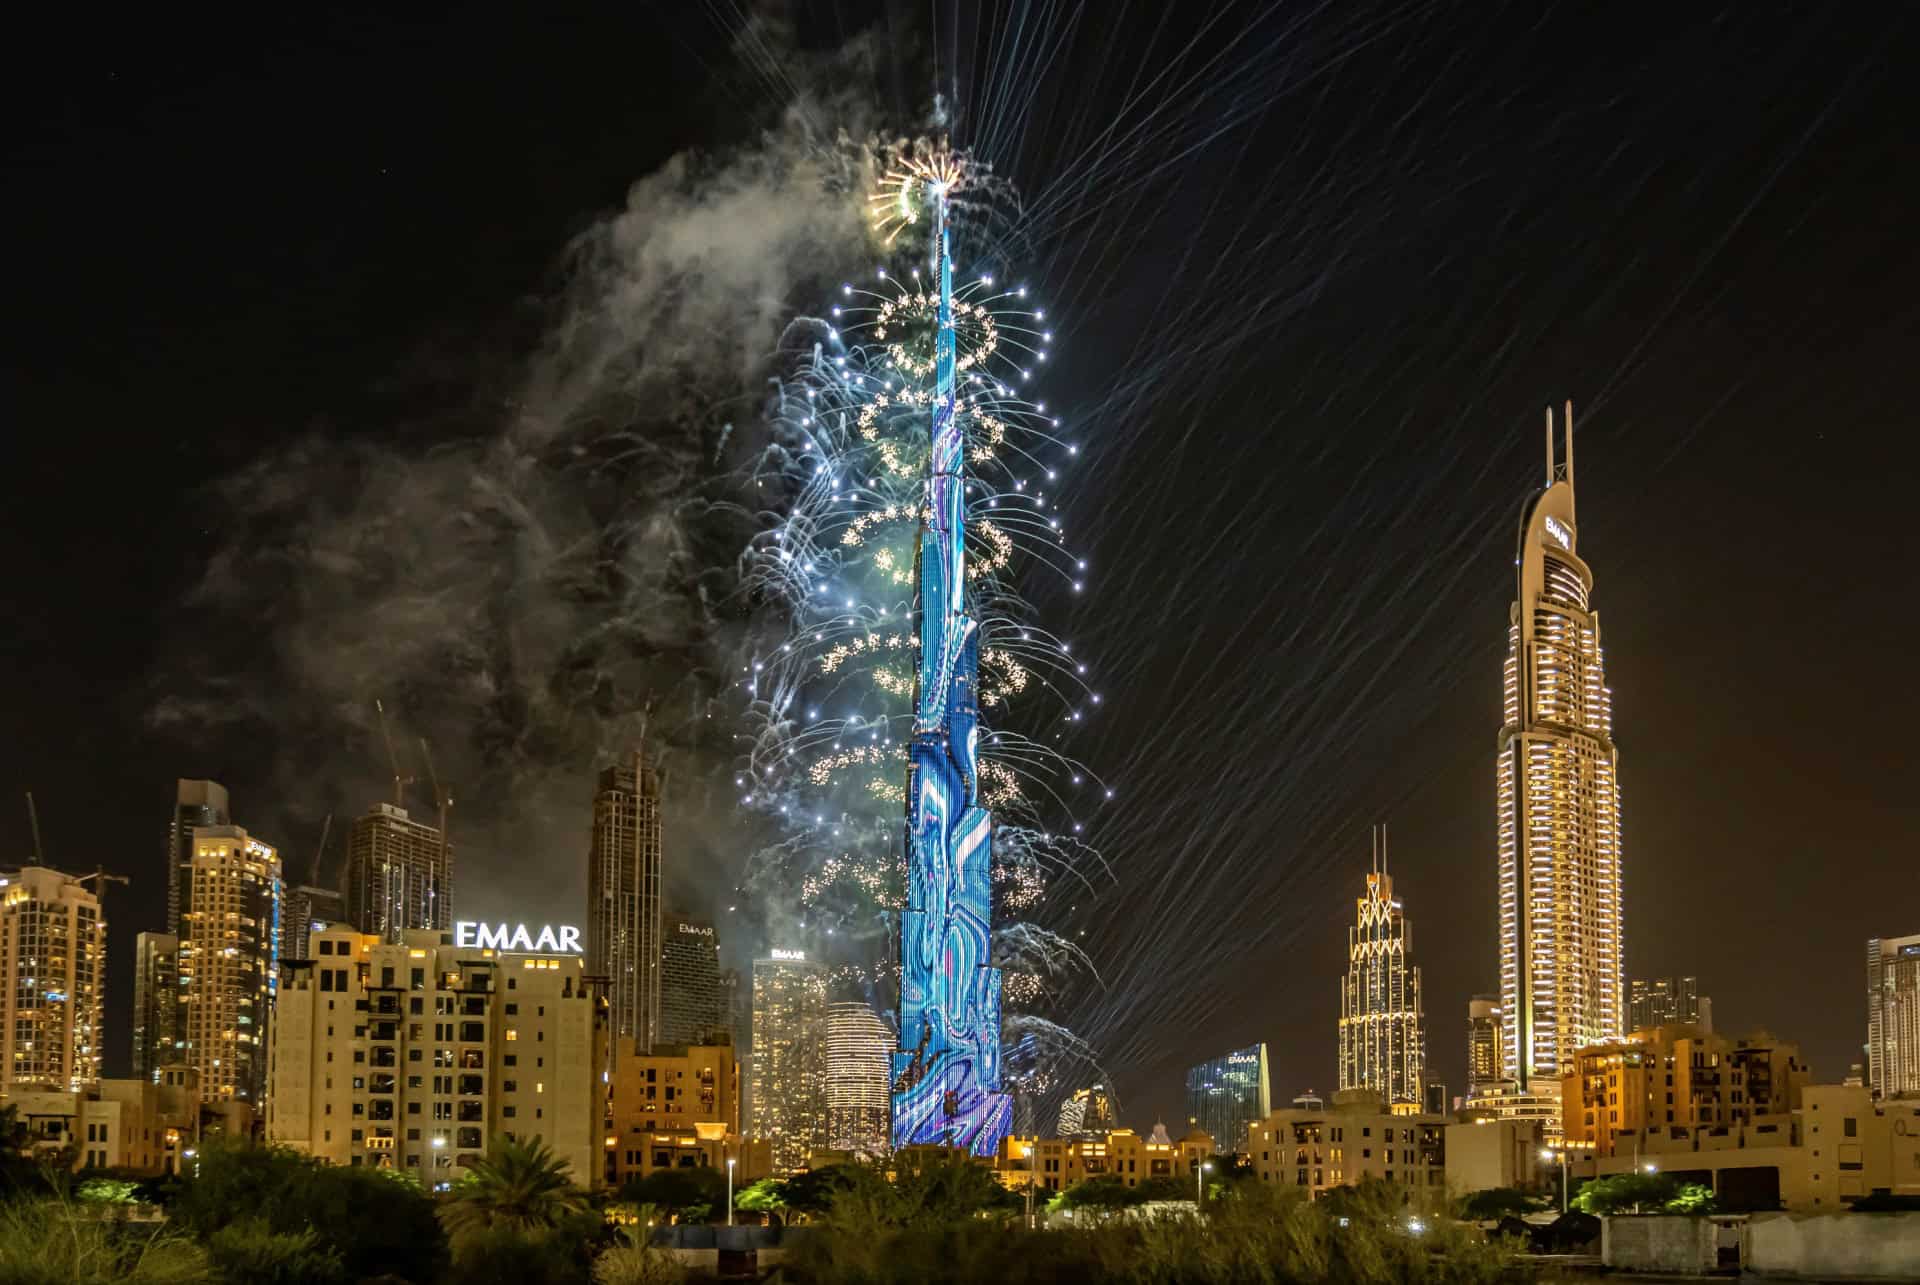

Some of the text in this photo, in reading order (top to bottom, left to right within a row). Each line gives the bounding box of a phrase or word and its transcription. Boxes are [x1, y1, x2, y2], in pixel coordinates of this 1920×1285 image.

[679, 923, 713, 936] EMAAR
[456, 921, 583, 952] EMAAR
[1228, 1055, 1256, 1064] EMAAR
